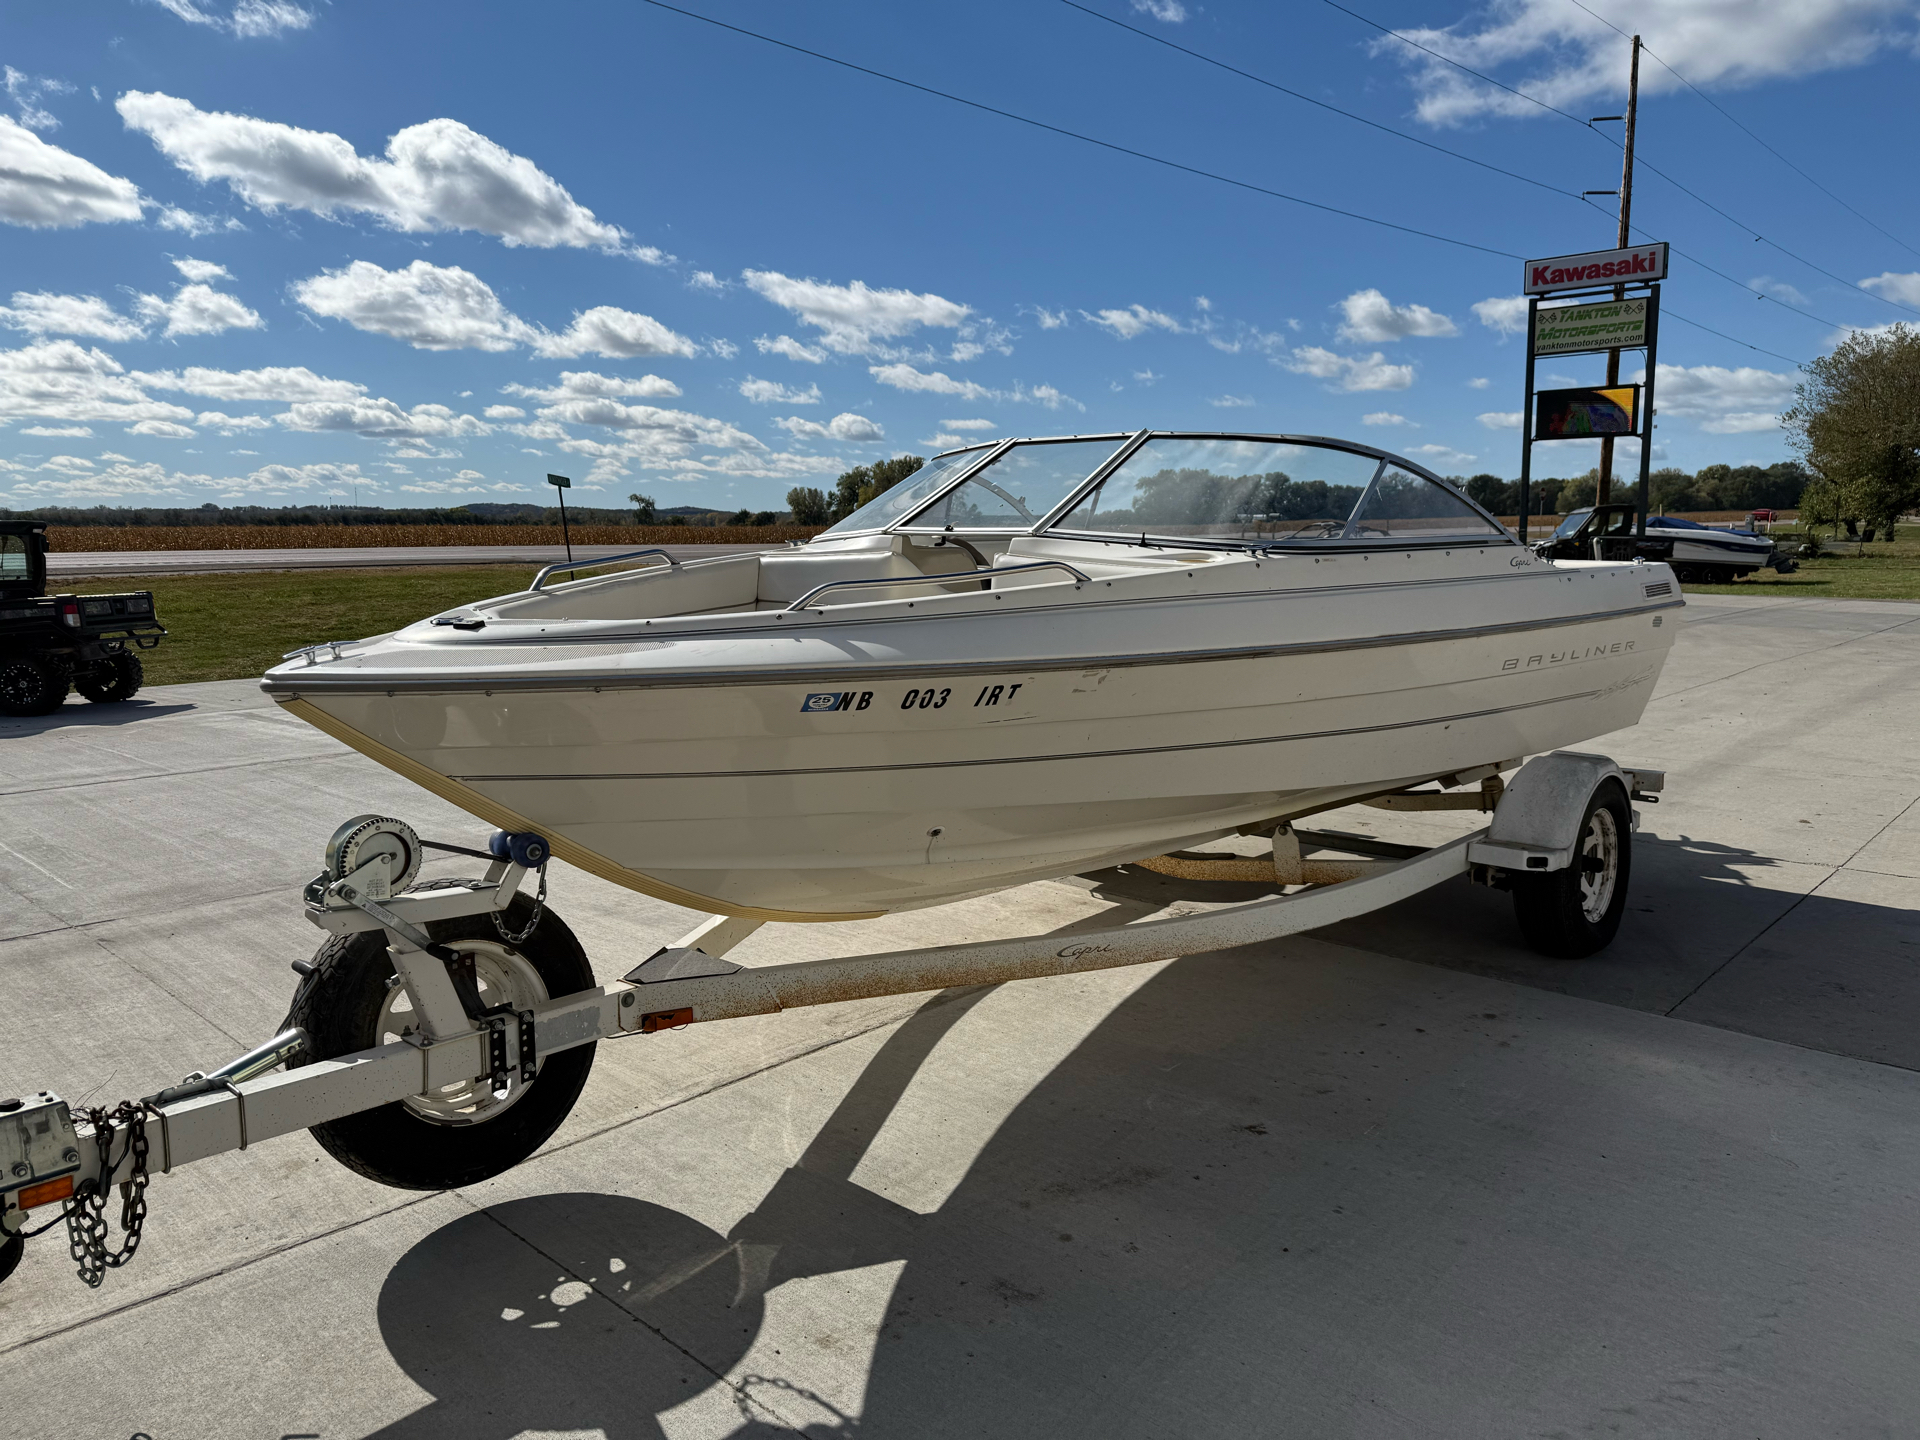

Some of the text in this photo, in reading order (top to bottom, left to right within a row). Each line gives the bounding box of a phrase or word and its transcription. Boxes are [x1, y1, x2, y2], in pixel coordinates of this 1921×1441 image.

[1532, 251, 1656, 287] Kawasaki
[1559, 305, 1623, 323] YANKTON
[1536, 320, 1644, 341] MOTORSPORTS
[1536, 333, 1643, 352] yanktonmotorsports.com
[1501, 640, 1636, 671] BAYLINER
[811, 696, 832, 704] 25
[835, 691, 874, 711] NB
[900, 688, 952, 710] 003
[1056, 942, 1115, 960] Capri
